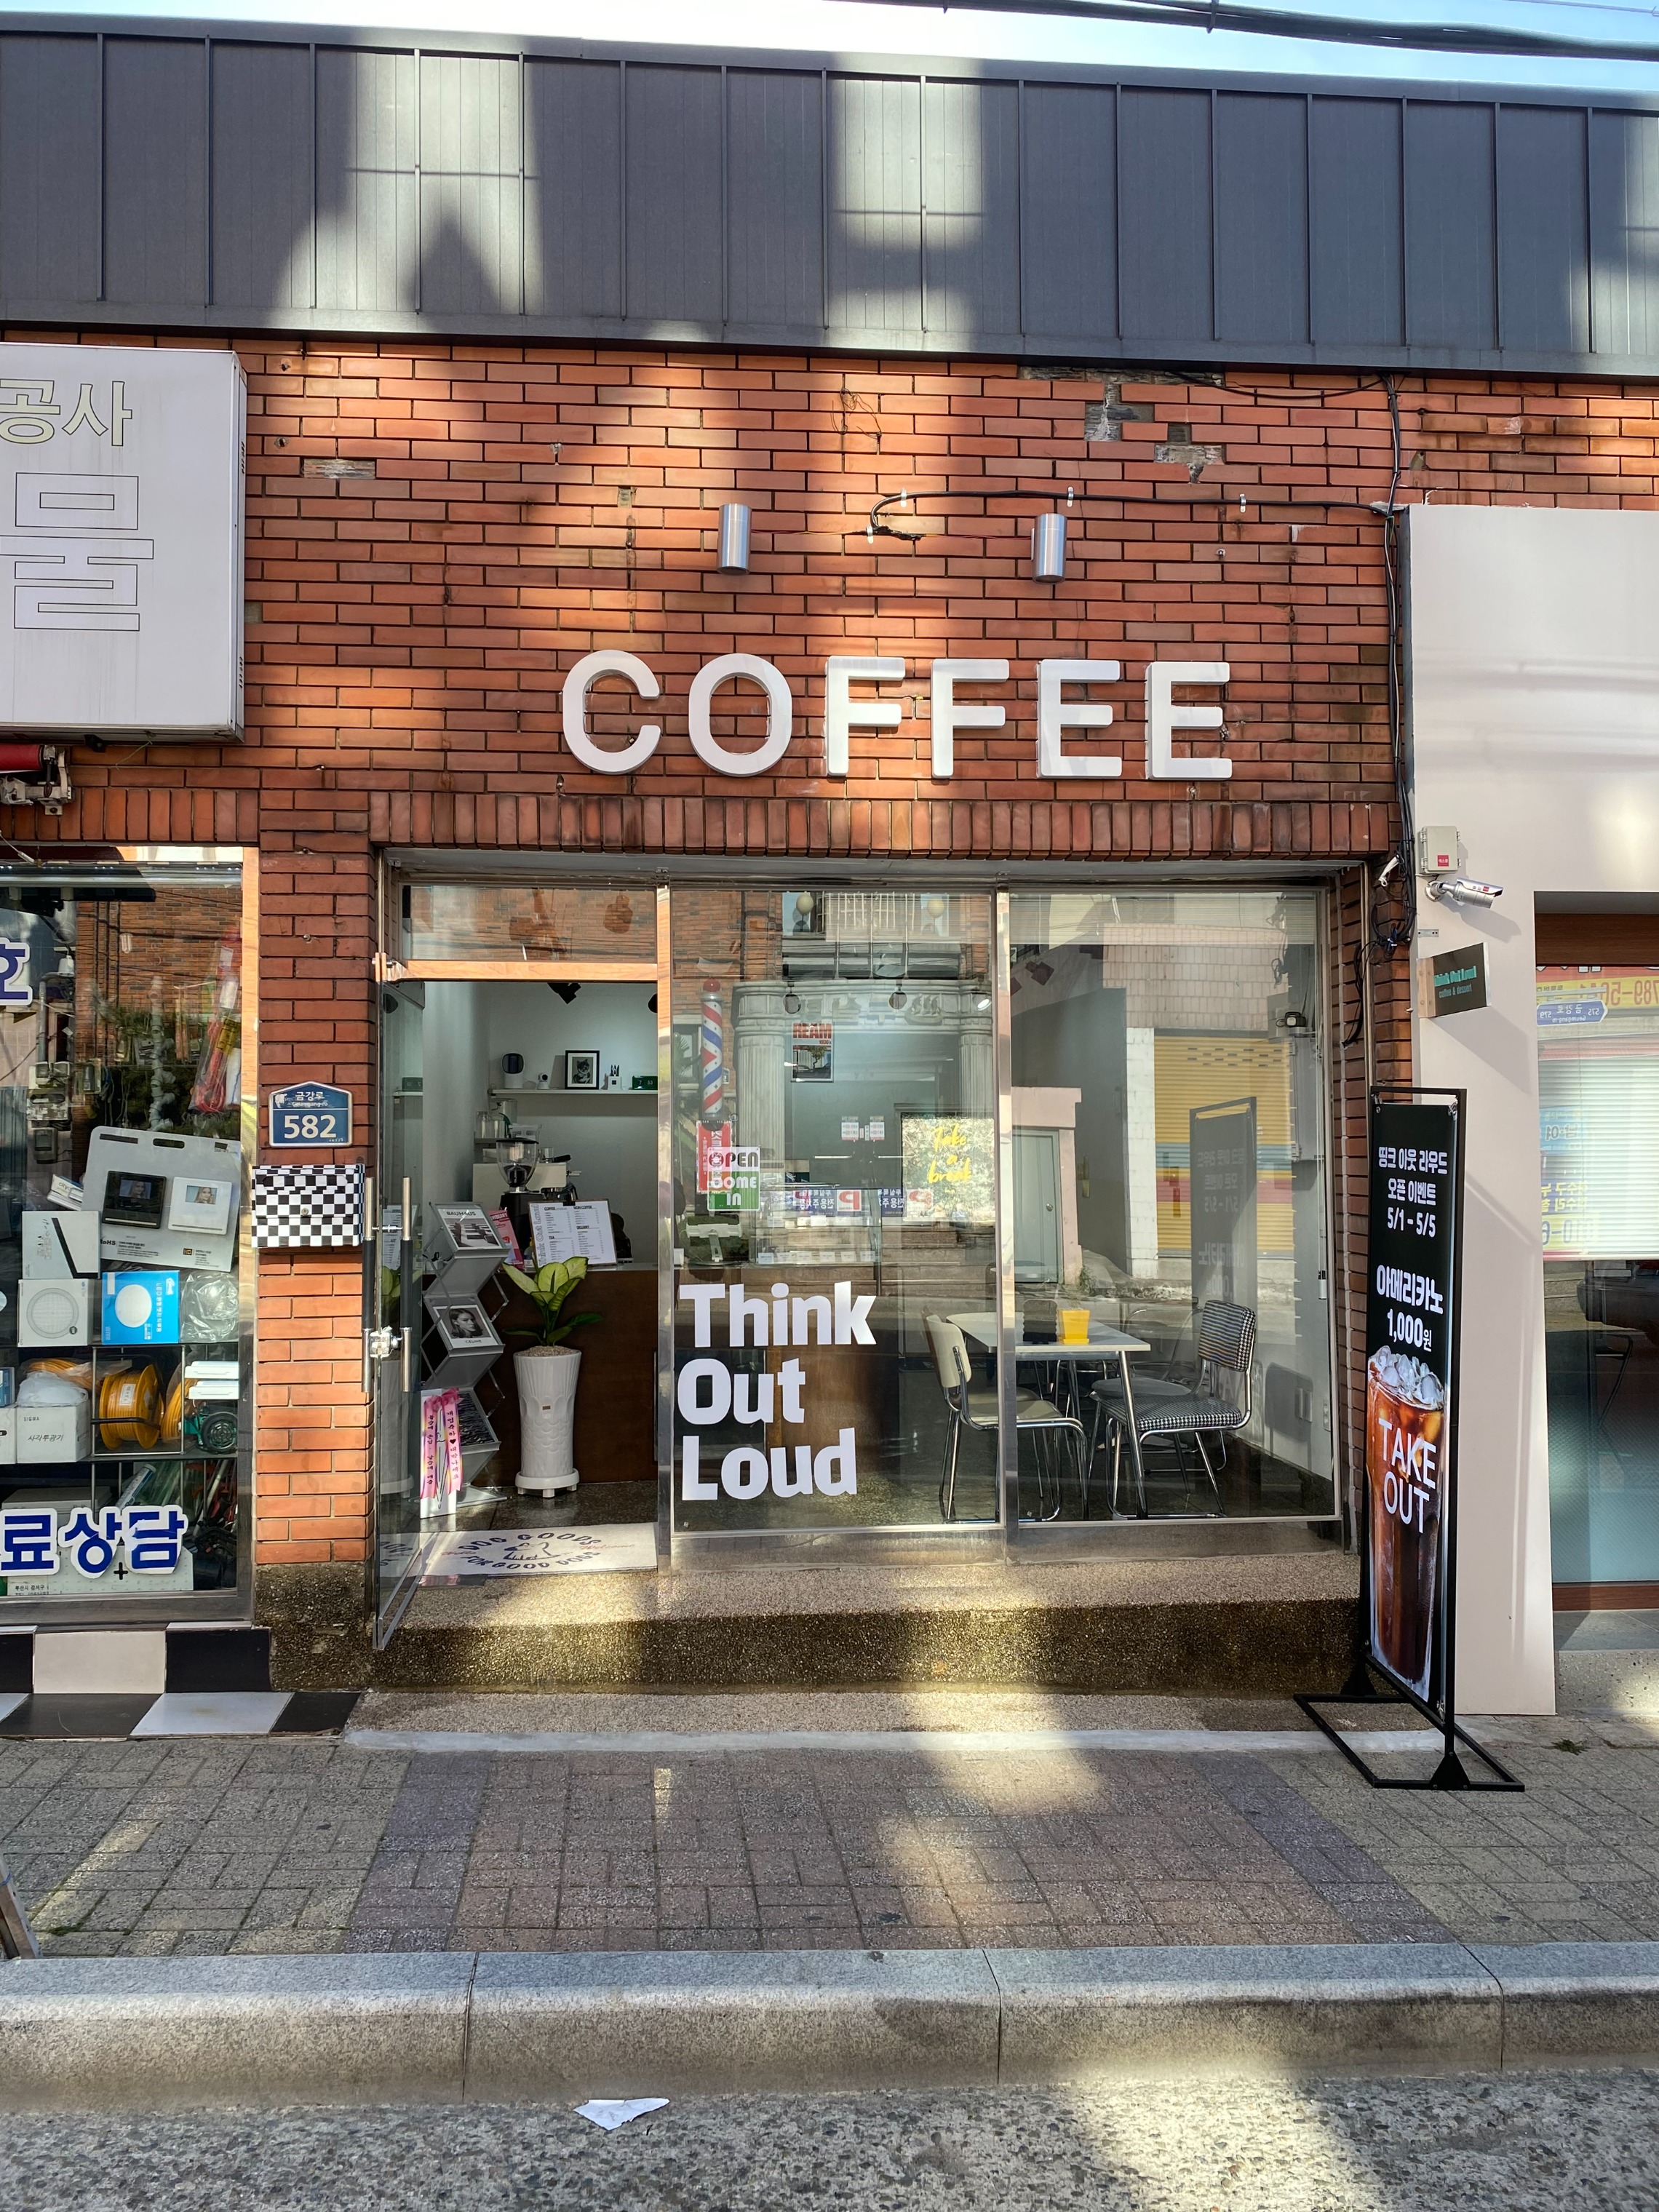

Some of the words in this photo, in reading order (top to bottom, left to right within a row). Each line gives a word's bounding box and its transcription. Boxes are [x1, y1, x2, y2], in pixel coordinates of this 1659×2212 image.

[561, 648, 1233, 780] COFFEE
[1439, 989, 1452, 998] coffee
[1452, 986, 1456, 995] &
[1457, 983, 1472, 995] dessert
[295, 1091, 325, 1102] 금강로
[284, 1114, 337, 1139] 582
[933, 1123, 967, 1153] Take
[709, 1152, 759, 1168] OPEN
[927, 1157, 972, 1184] break
[946, 1154, 958, 1165] a
[1378, 1146, 1396, 1169] 띵크
[1399, 1148, 1417, 1171] 아웃
[1419, 1150, 1448, 1175] 라우드
[711, 1176, 757, 1189] COME
[1388, 1177, 1406, 1201] 오픈
[1408, 1180, 1436, 1206] 이벤트
[726, 1193, 741, 1206] IN
[536, 1225, 544, 1242] Out
[1387, 1206, 1404, 1231] 5/1
[1416, 1212, 1436, 1238] 5/5
[1376, 1265, 1444, 1315] 아메리카노
[679, 1281, 877, 1348] Think
[1387, 1308, 1432, 1353] 1,000원
[677, 1358, 805, 1425] Out
[682, 1427, 857, 1500] Loud
[1378, 1417, 1436, 1489] TAKE
[1384, 1471, 1430, 1534] OUT
[1, 1511, 185, 1574] 료상담
[458, 1537, 507, 1550] DOG
[517, 1532, 602, 1545] GOODS
[555, 1551, 601, 1566] DOGS
